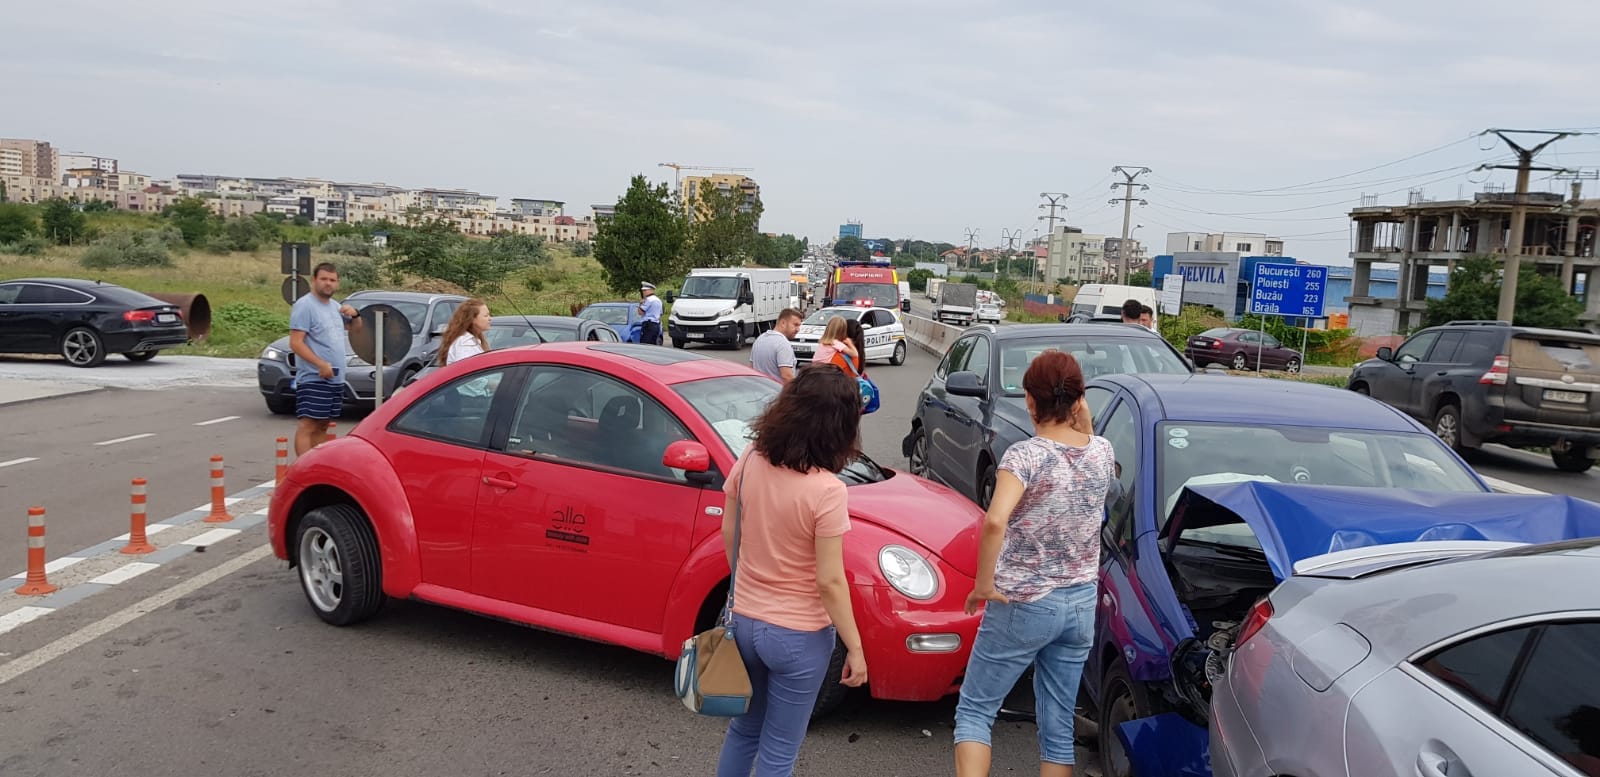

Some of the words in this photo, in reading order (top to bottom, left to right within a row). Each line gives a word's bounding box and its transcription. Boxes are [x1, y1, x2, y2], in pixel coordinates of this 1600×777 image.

[1306, 270, 1321, 278] 260
[1305, 282, 1320, 290] 255
[1304, 294, 1318, 303] 223
[1302, 306, 1315, 315] 165
